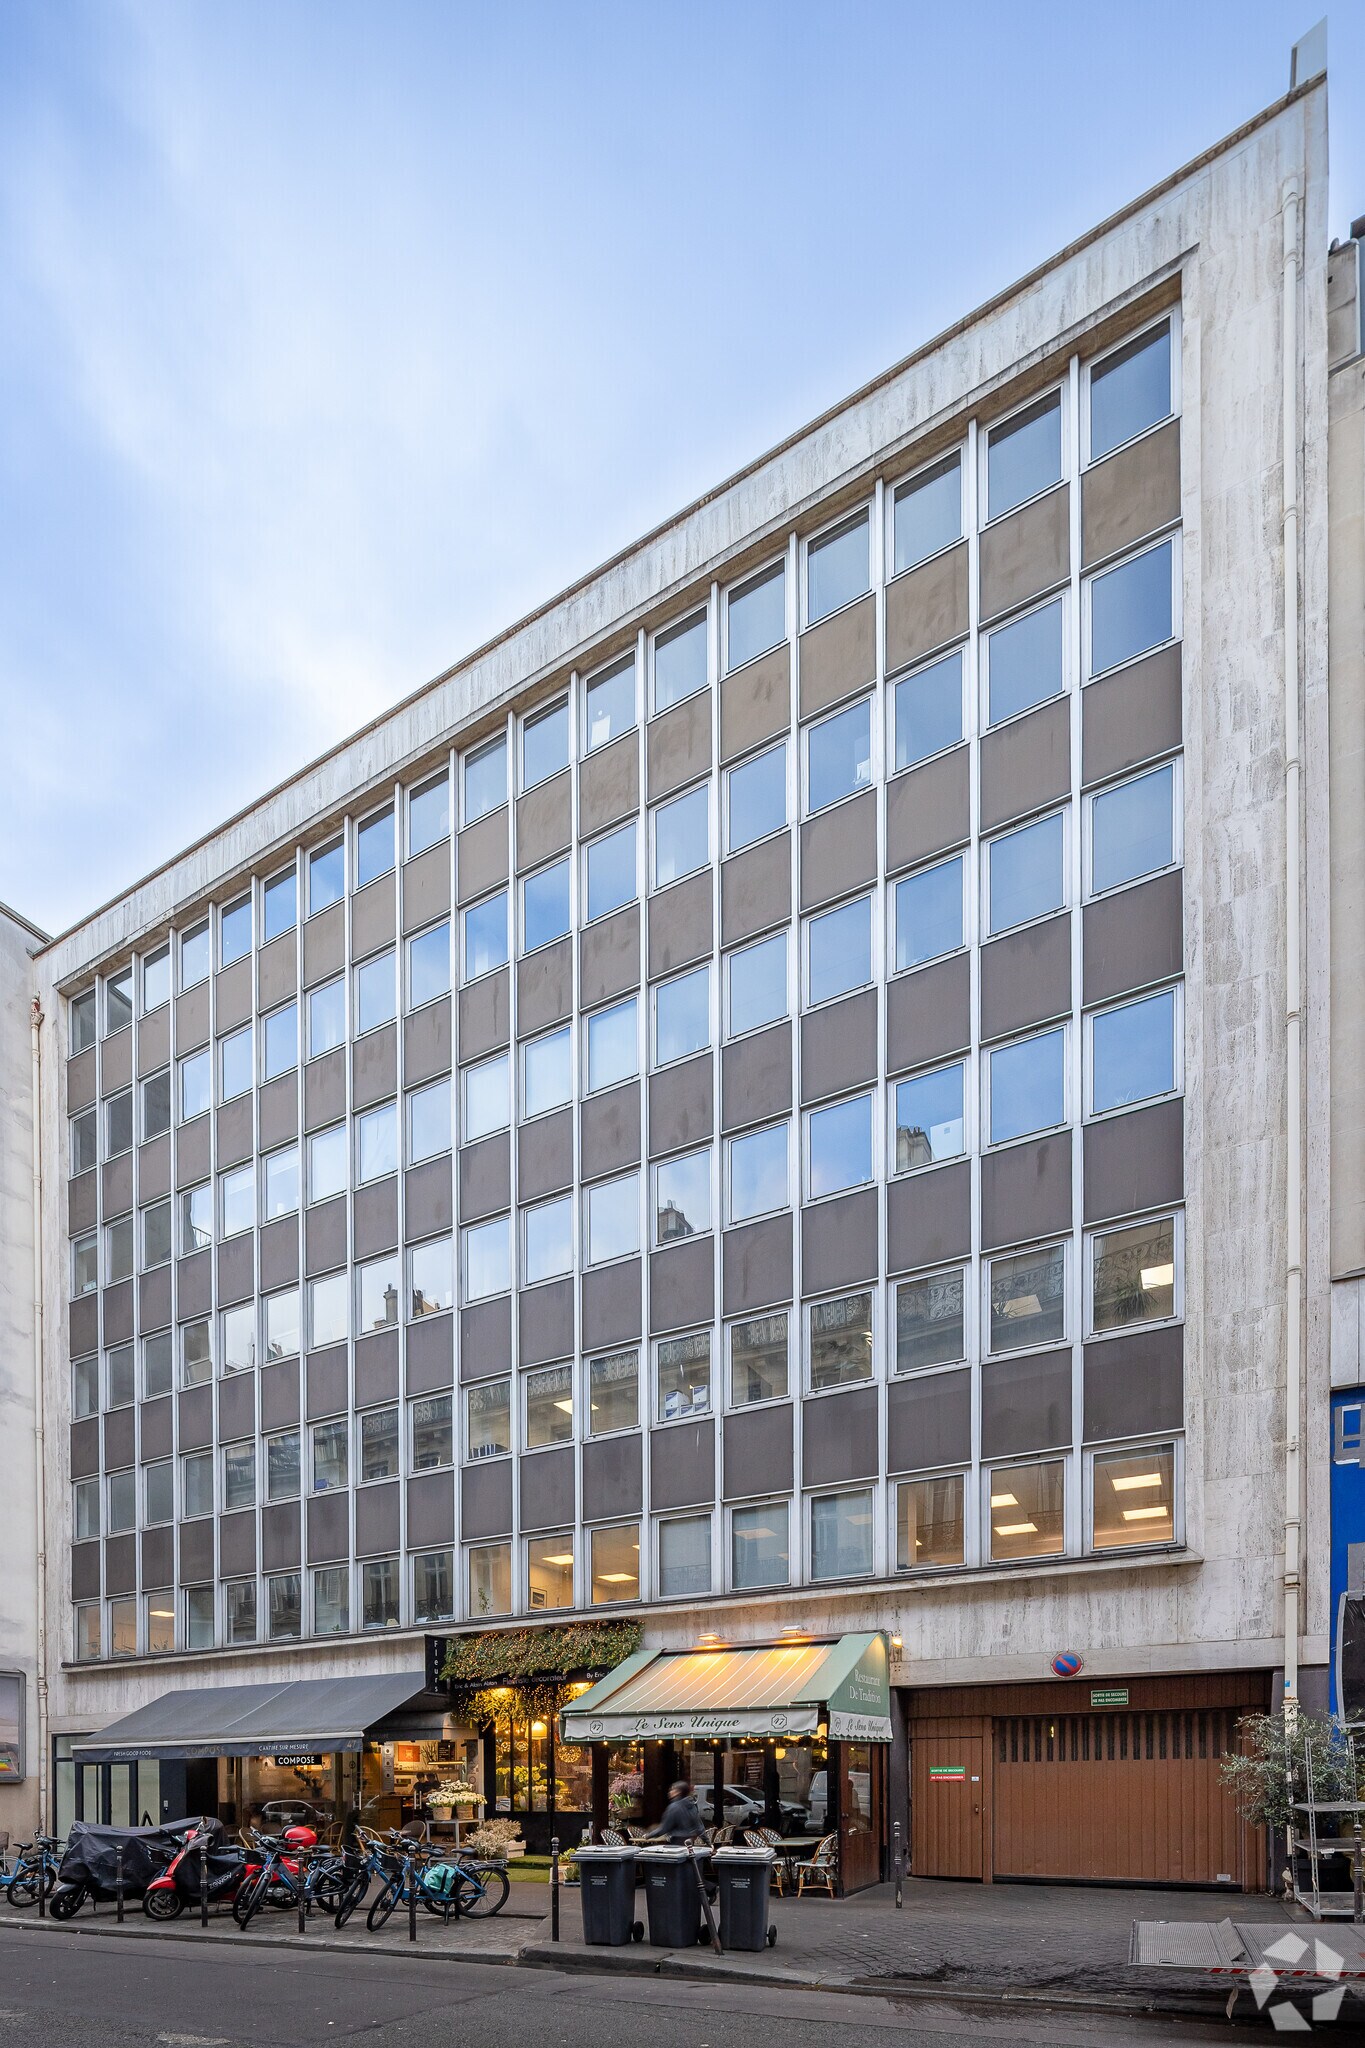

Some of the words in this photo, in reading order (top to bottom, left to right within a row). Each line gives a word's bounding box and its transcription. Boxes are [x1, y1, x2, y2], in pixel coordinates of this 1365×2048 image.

[586, 1672, 594, 1680] By
[854, 1669, 881, 1687] Restaurant
[849, 1685, 858, 1700] De
[859, 1687, 881, 1704] Tradition
[630, 1718, 649, 1732] Le
[653, 1717, 684, 1729] Sens
[690, 1715, 741, 1732] Unique
[846, 1718, 853, 1732] Le
[855, 1719, 867, 1731] Sens
[868, 1720, 885, 1736] Unique
[185, 1745, 225, 1756] COMPOSE
[258, 1744, 279, 1752] CANTINE
[290, 1743, 309, 1751] MESURE
[278, 1756, 315, 1765] COMPOSE
